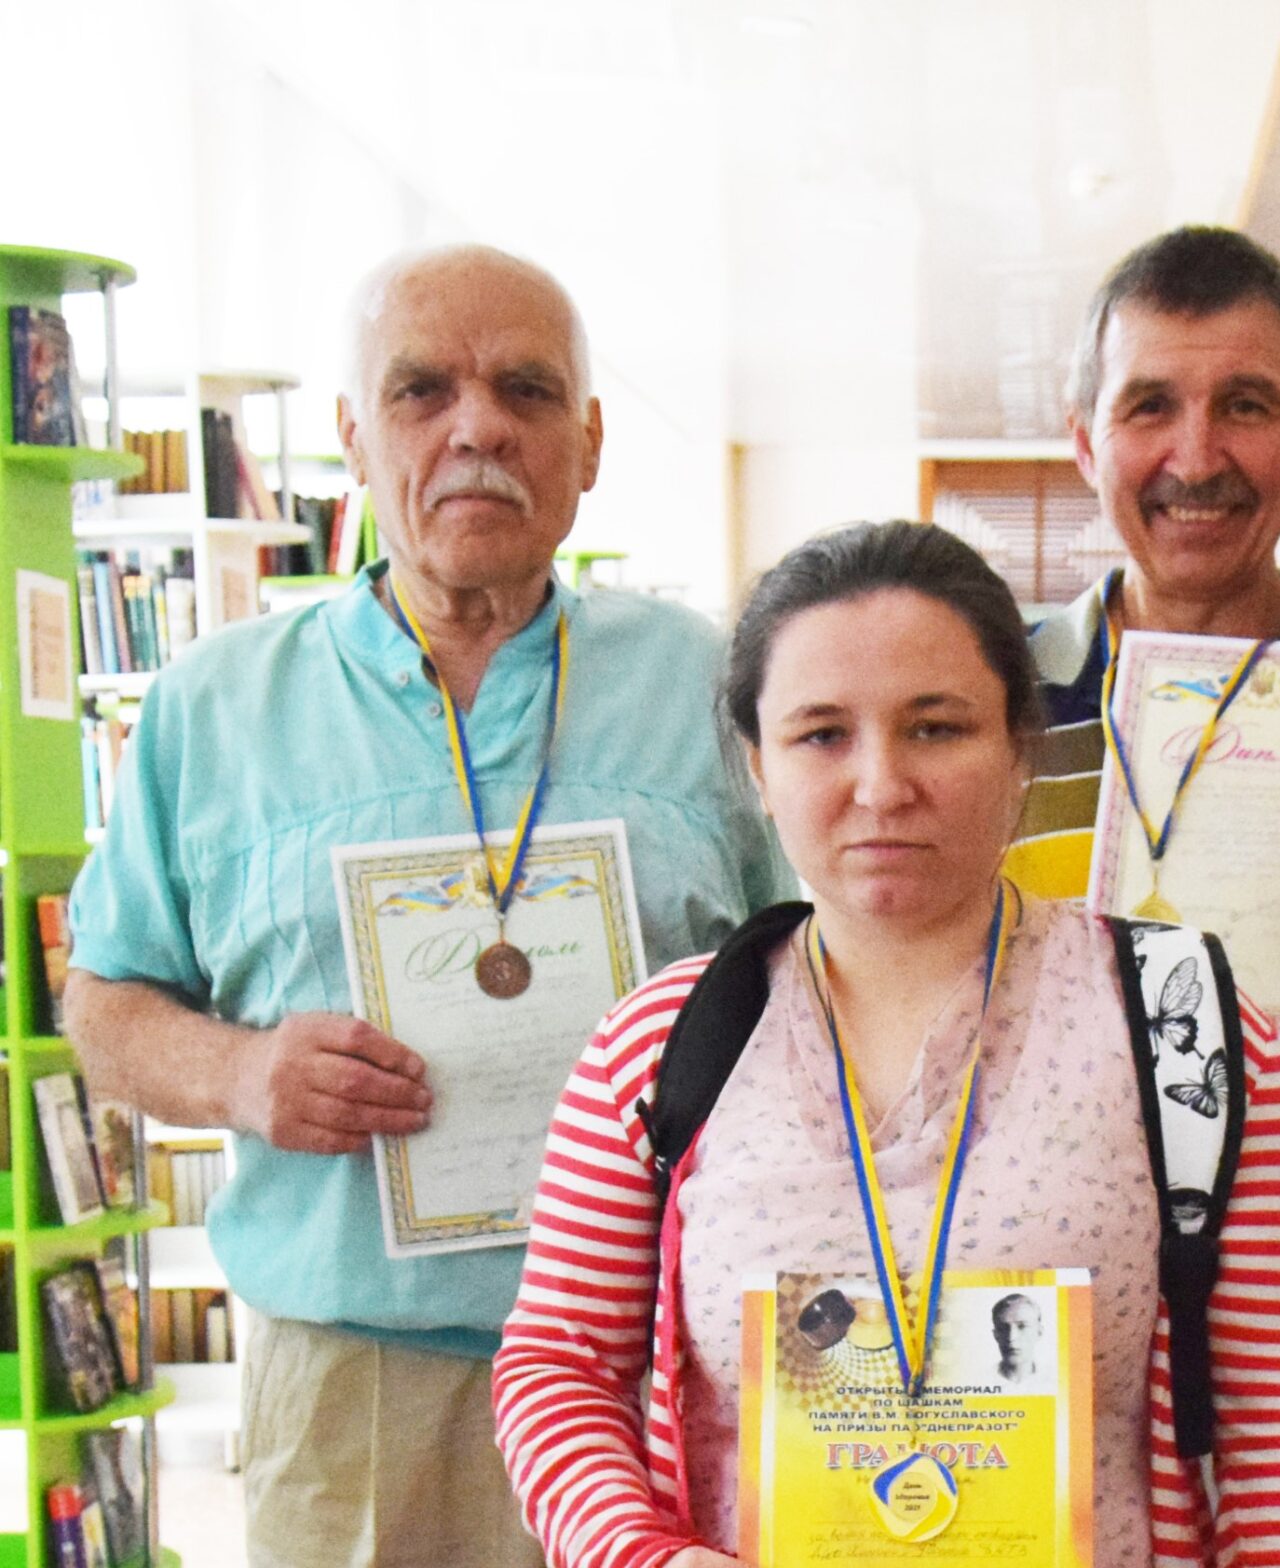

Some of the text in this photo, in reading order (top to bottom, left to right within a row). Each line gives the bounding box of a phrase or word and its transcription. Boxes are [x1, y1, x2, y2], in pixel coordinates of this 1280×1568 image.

[405, 925, 581, 984] Длом
[873, 1399, 893, 1408] ПО
[808, 1411, 867, 1420] ПАМЯТИ
[813, 1424, 832, 1433] НА
[837, 1424, 887, 1433] ПРИЗЫ
